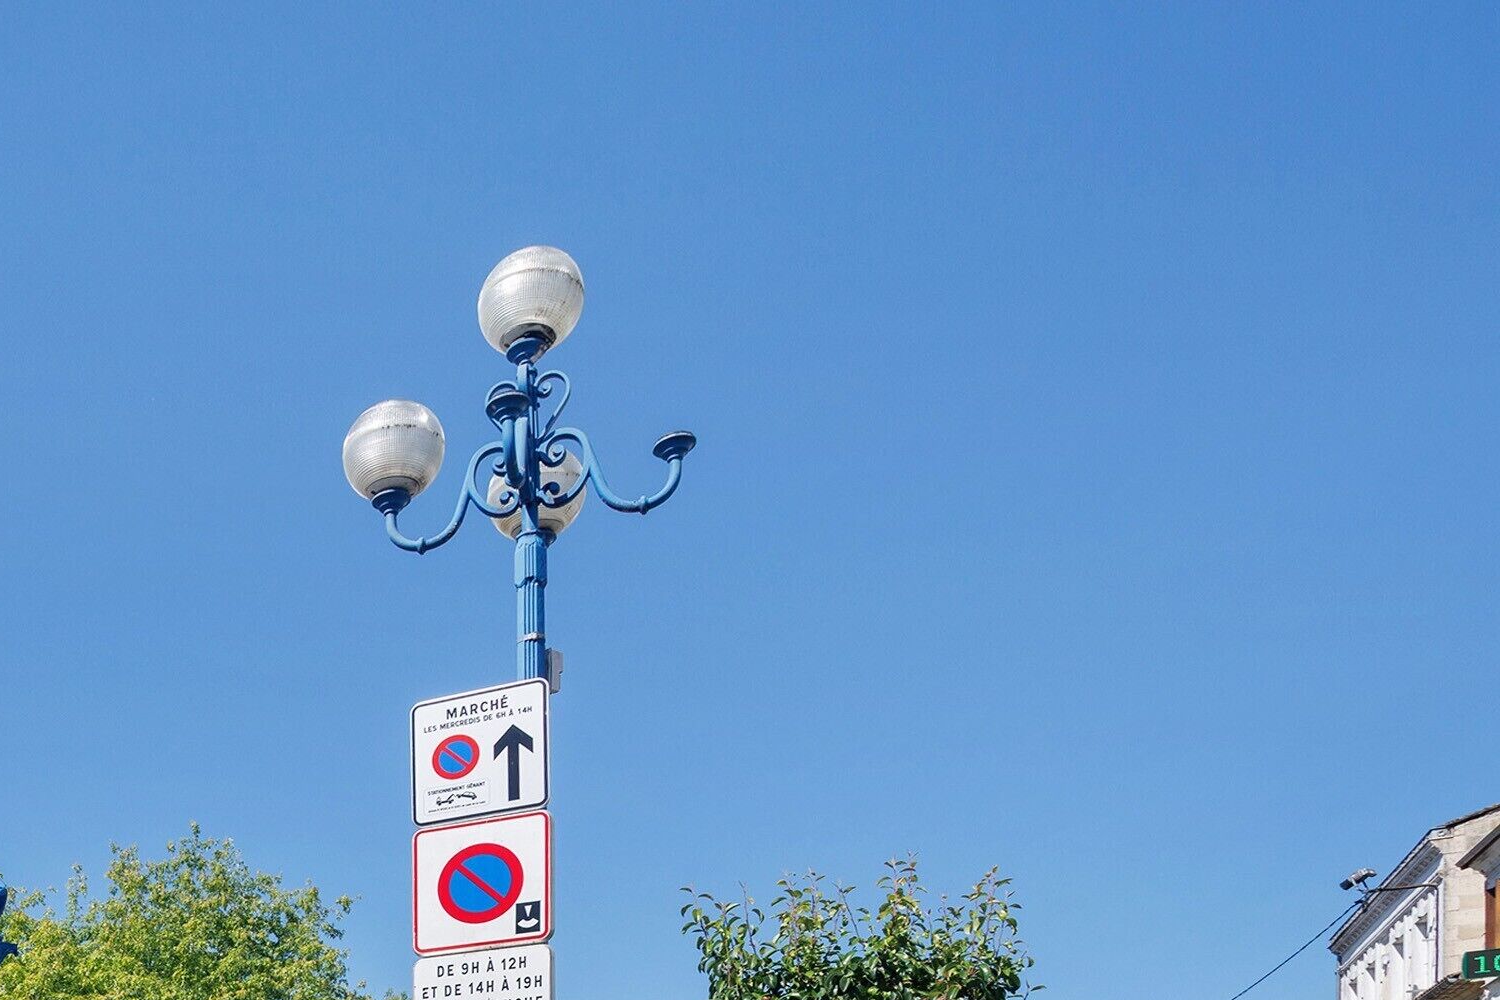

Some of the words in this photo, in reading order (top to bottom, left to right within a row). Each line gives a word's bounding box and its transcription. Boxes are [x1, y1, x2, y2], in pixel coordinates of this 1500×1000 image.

[423, 723, 437, 734] LES
[439, 716, 481, 730] MERCREDIS
[483, 713, 493, 722] DE
[496, 711, 506, 719] 6H
[518, 705, 533, 714] 14H
[446, 694, 508, 720] MARCHÉ
[427, 784, 466, 796] STATIONNEMENT
[437, 964, 455, 978] DE
[461, 961, 479, 975] 9H
[486, 956, 495, 973] À
[501, 956, 527, 971] 12H
[422, 986, 438, 1000] ET
[444, 983, 462, 997] DE
[469, 980, 495, 994] 14H
[501, 975, 510, 991] À
[516, 974, 543, 990] 19H
